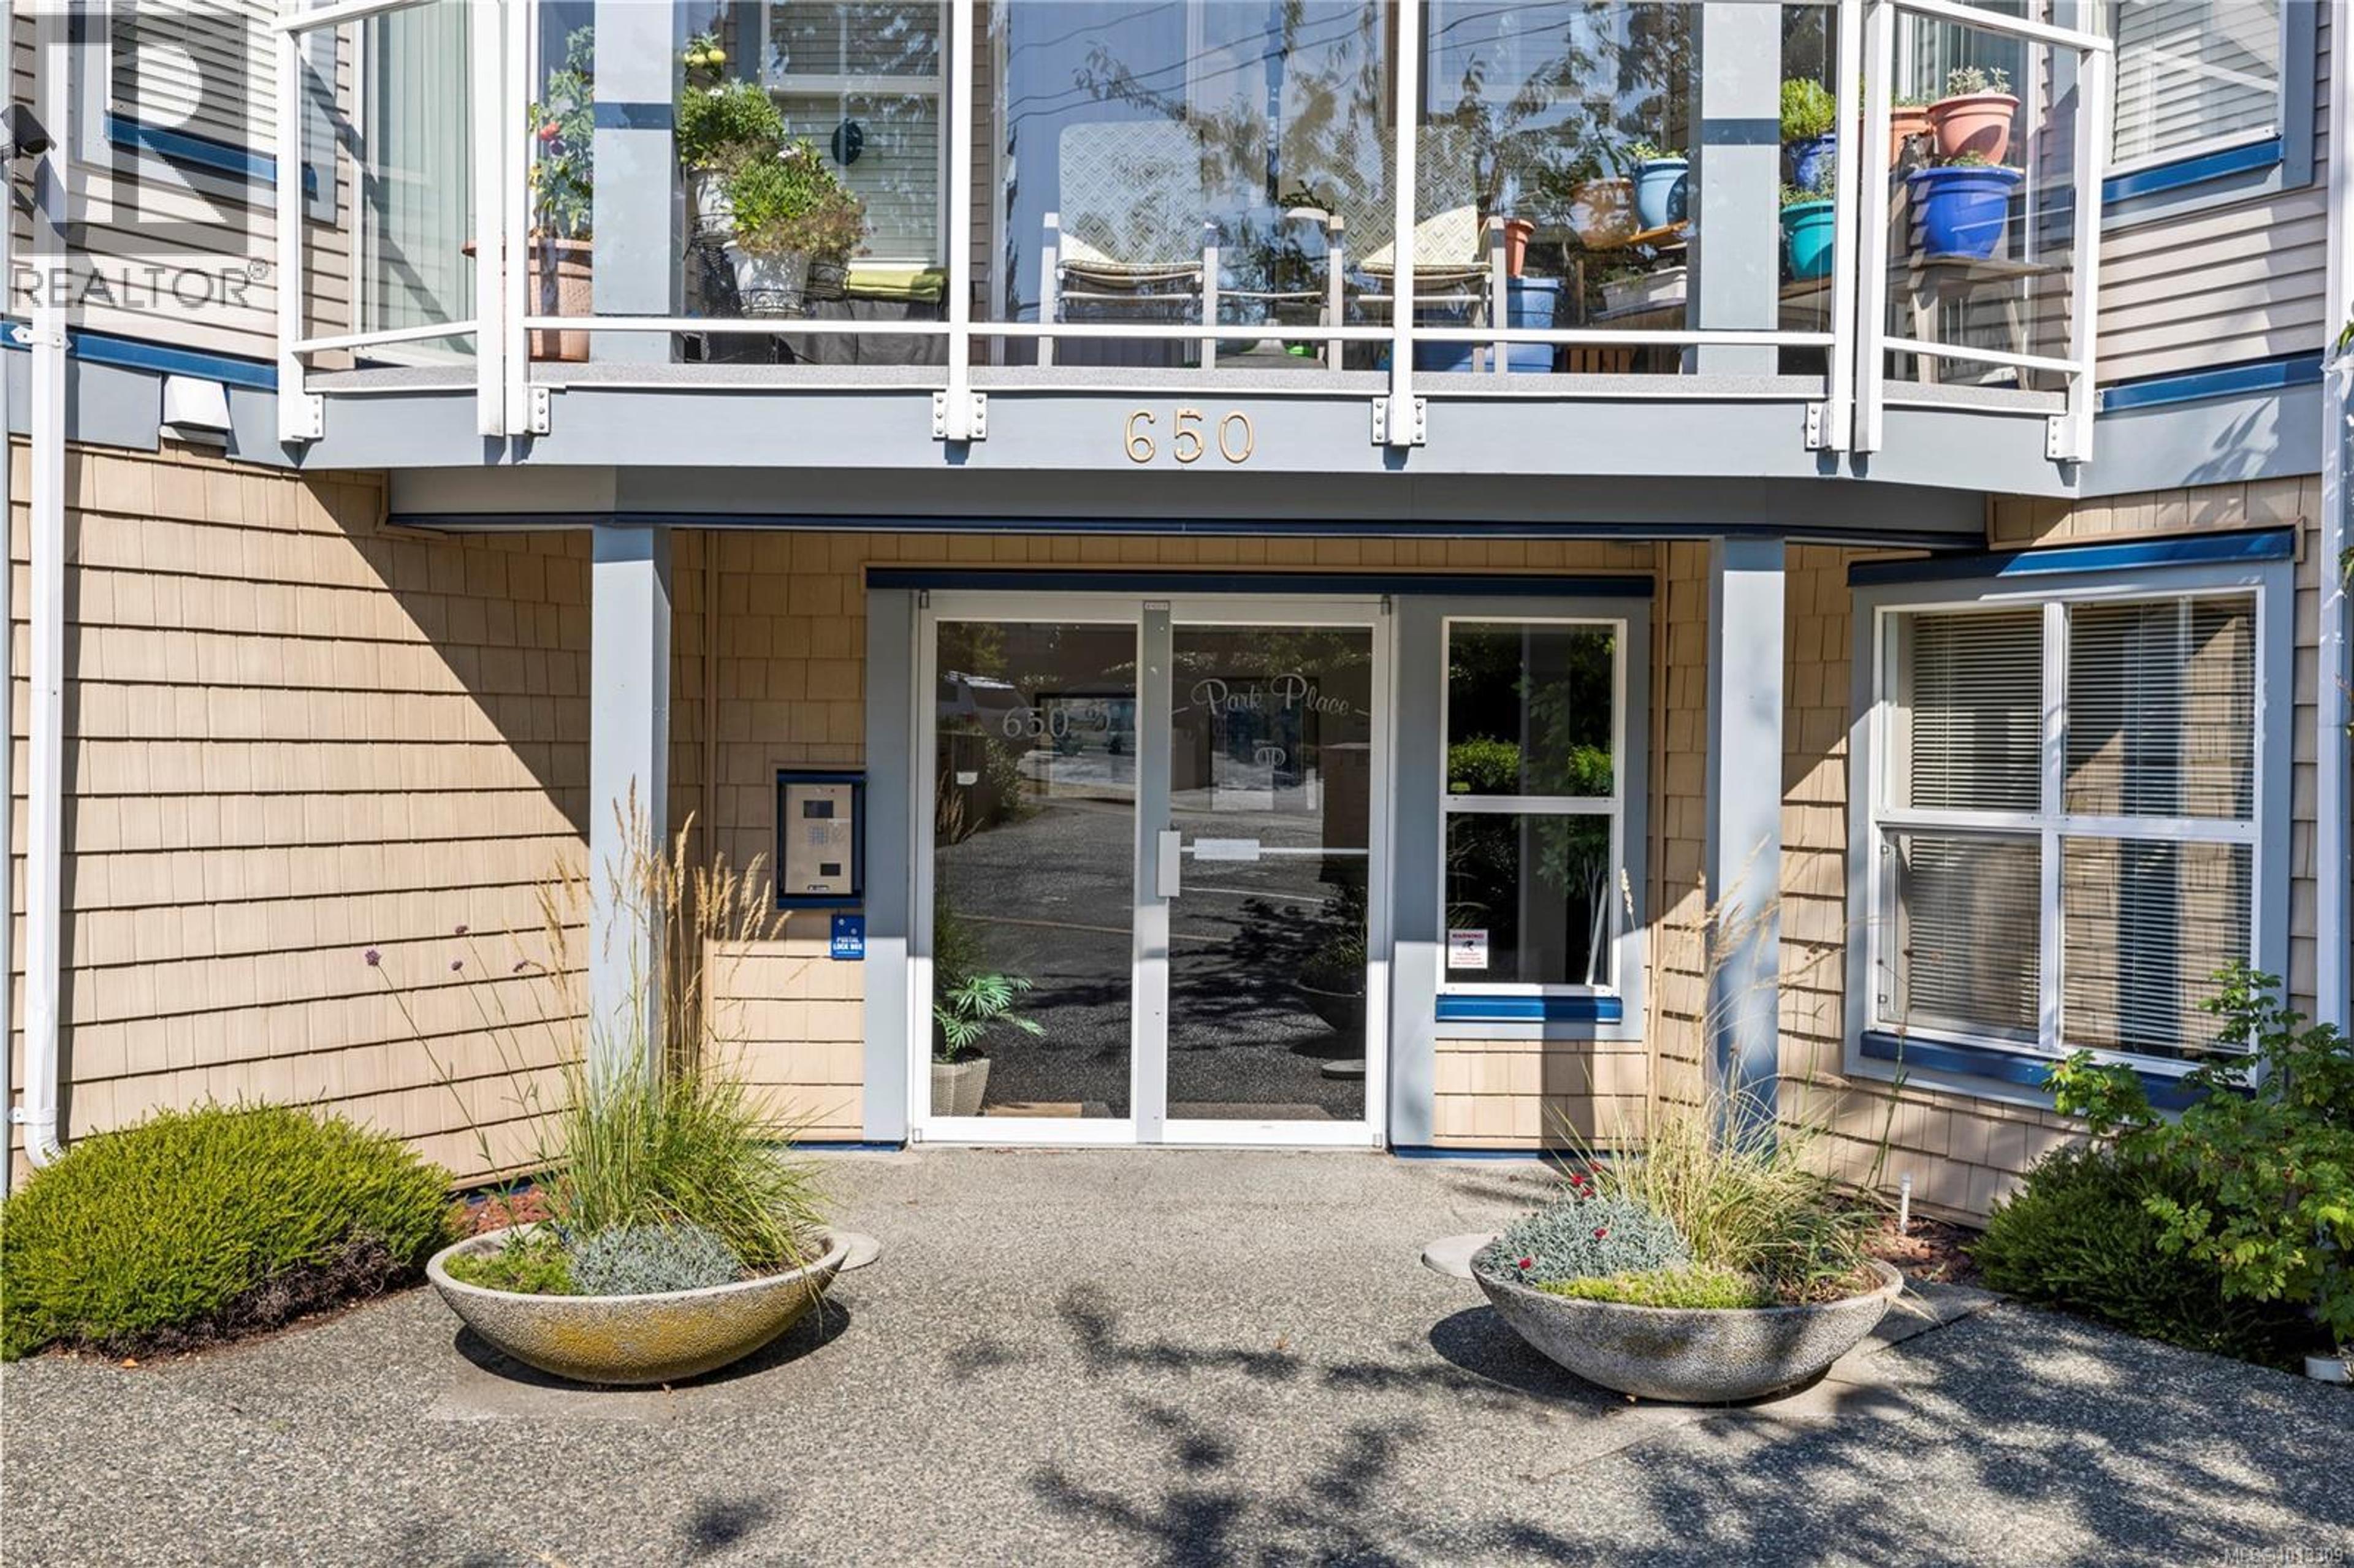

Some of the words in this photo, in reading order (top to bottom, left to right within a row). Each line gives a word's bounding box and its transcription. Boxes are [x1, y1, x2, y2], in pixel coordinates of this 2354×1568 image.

[1124, 408, 1254, 464] 650
[1190, 678, 1262, 716] Park
[1270, 672, 1349, 716] Place
[1003, 706, 1068, 738] 650
